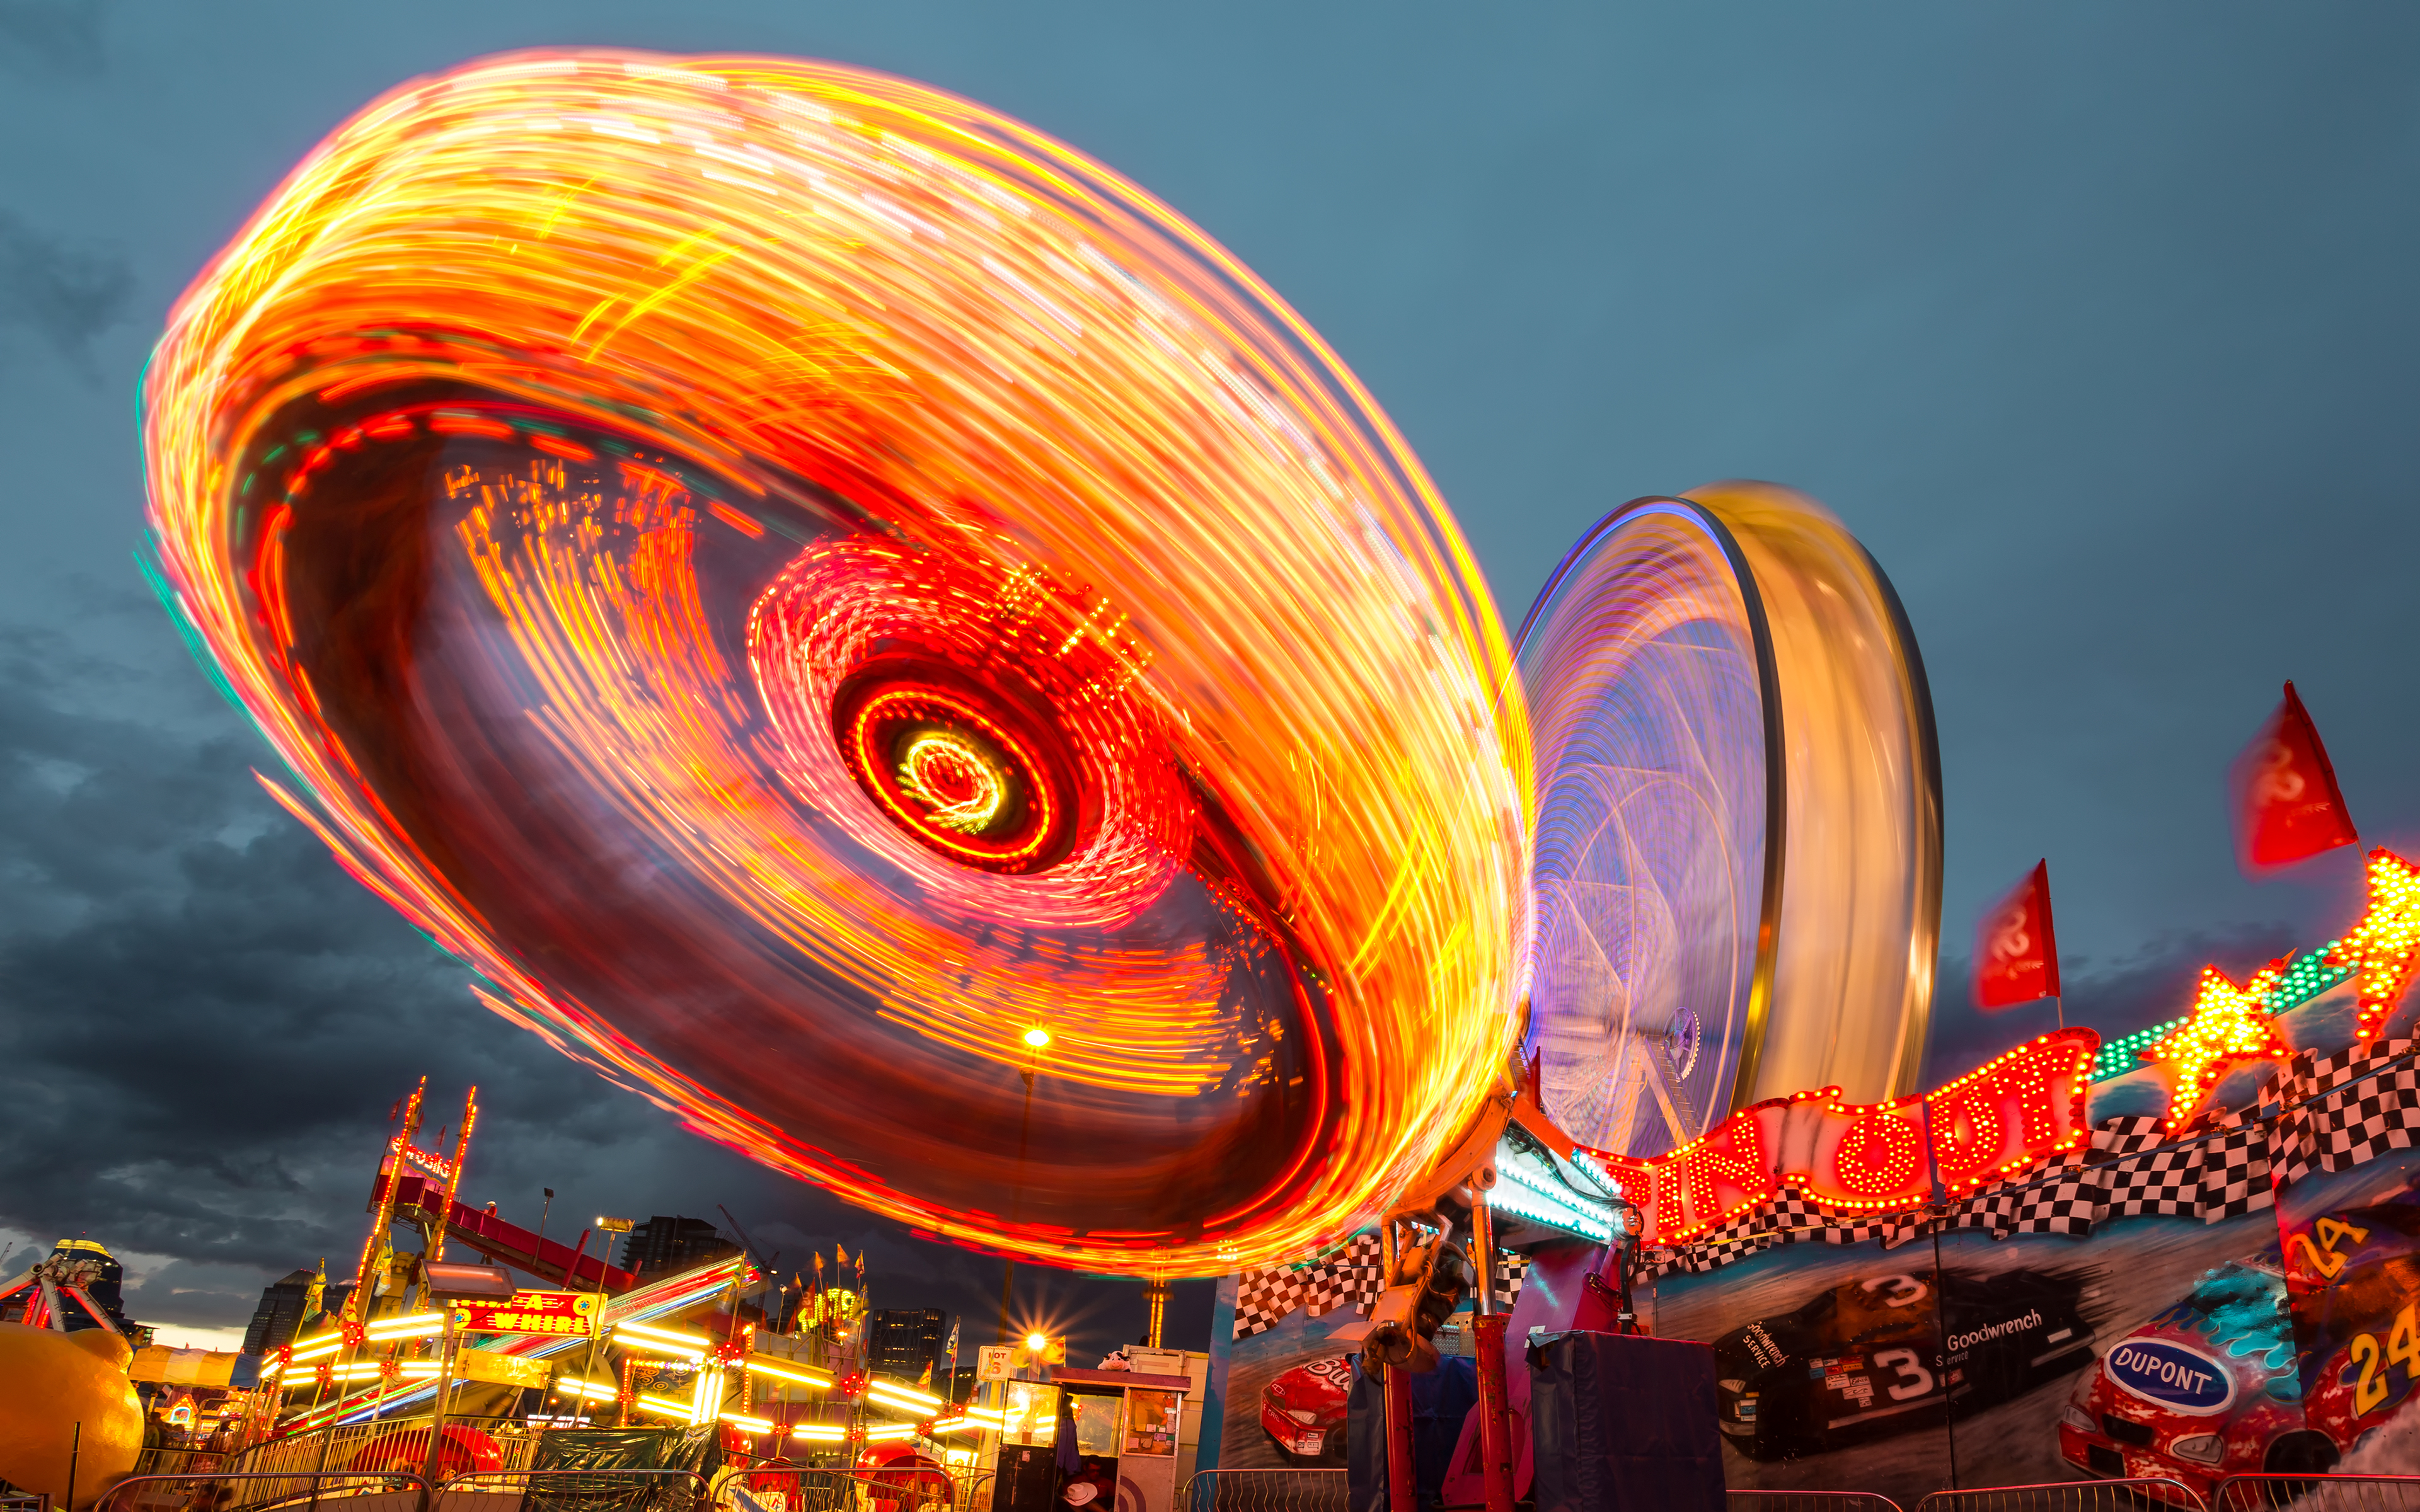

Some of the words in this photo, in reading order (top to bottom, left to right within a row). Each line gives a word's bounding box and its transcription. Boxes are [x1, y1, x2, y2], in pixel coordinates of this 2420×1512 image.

[1834, 1044, 2082, 1194] OUT
[2286, 1216, 2370, 1279] 24
[1861, 1274, 1928, 1308] 3
[494, 1312, 587, 1334] WHIRL
[1747, 1320, 1790, 1368] Goodwrench
[1947, 1309, 2042, 1351] Goodwrench
[991, 1361, 1001, 1375] 6
[1743, 1335, 1771, 1368] SERVICE
[1936, 1351, 1969, 1366] Service
[2114, 1348, 2213, 1395] DUPONT
[2349, 1302, 2420, 1419] 24
[1873, 1348, 1933, 1400] 3
